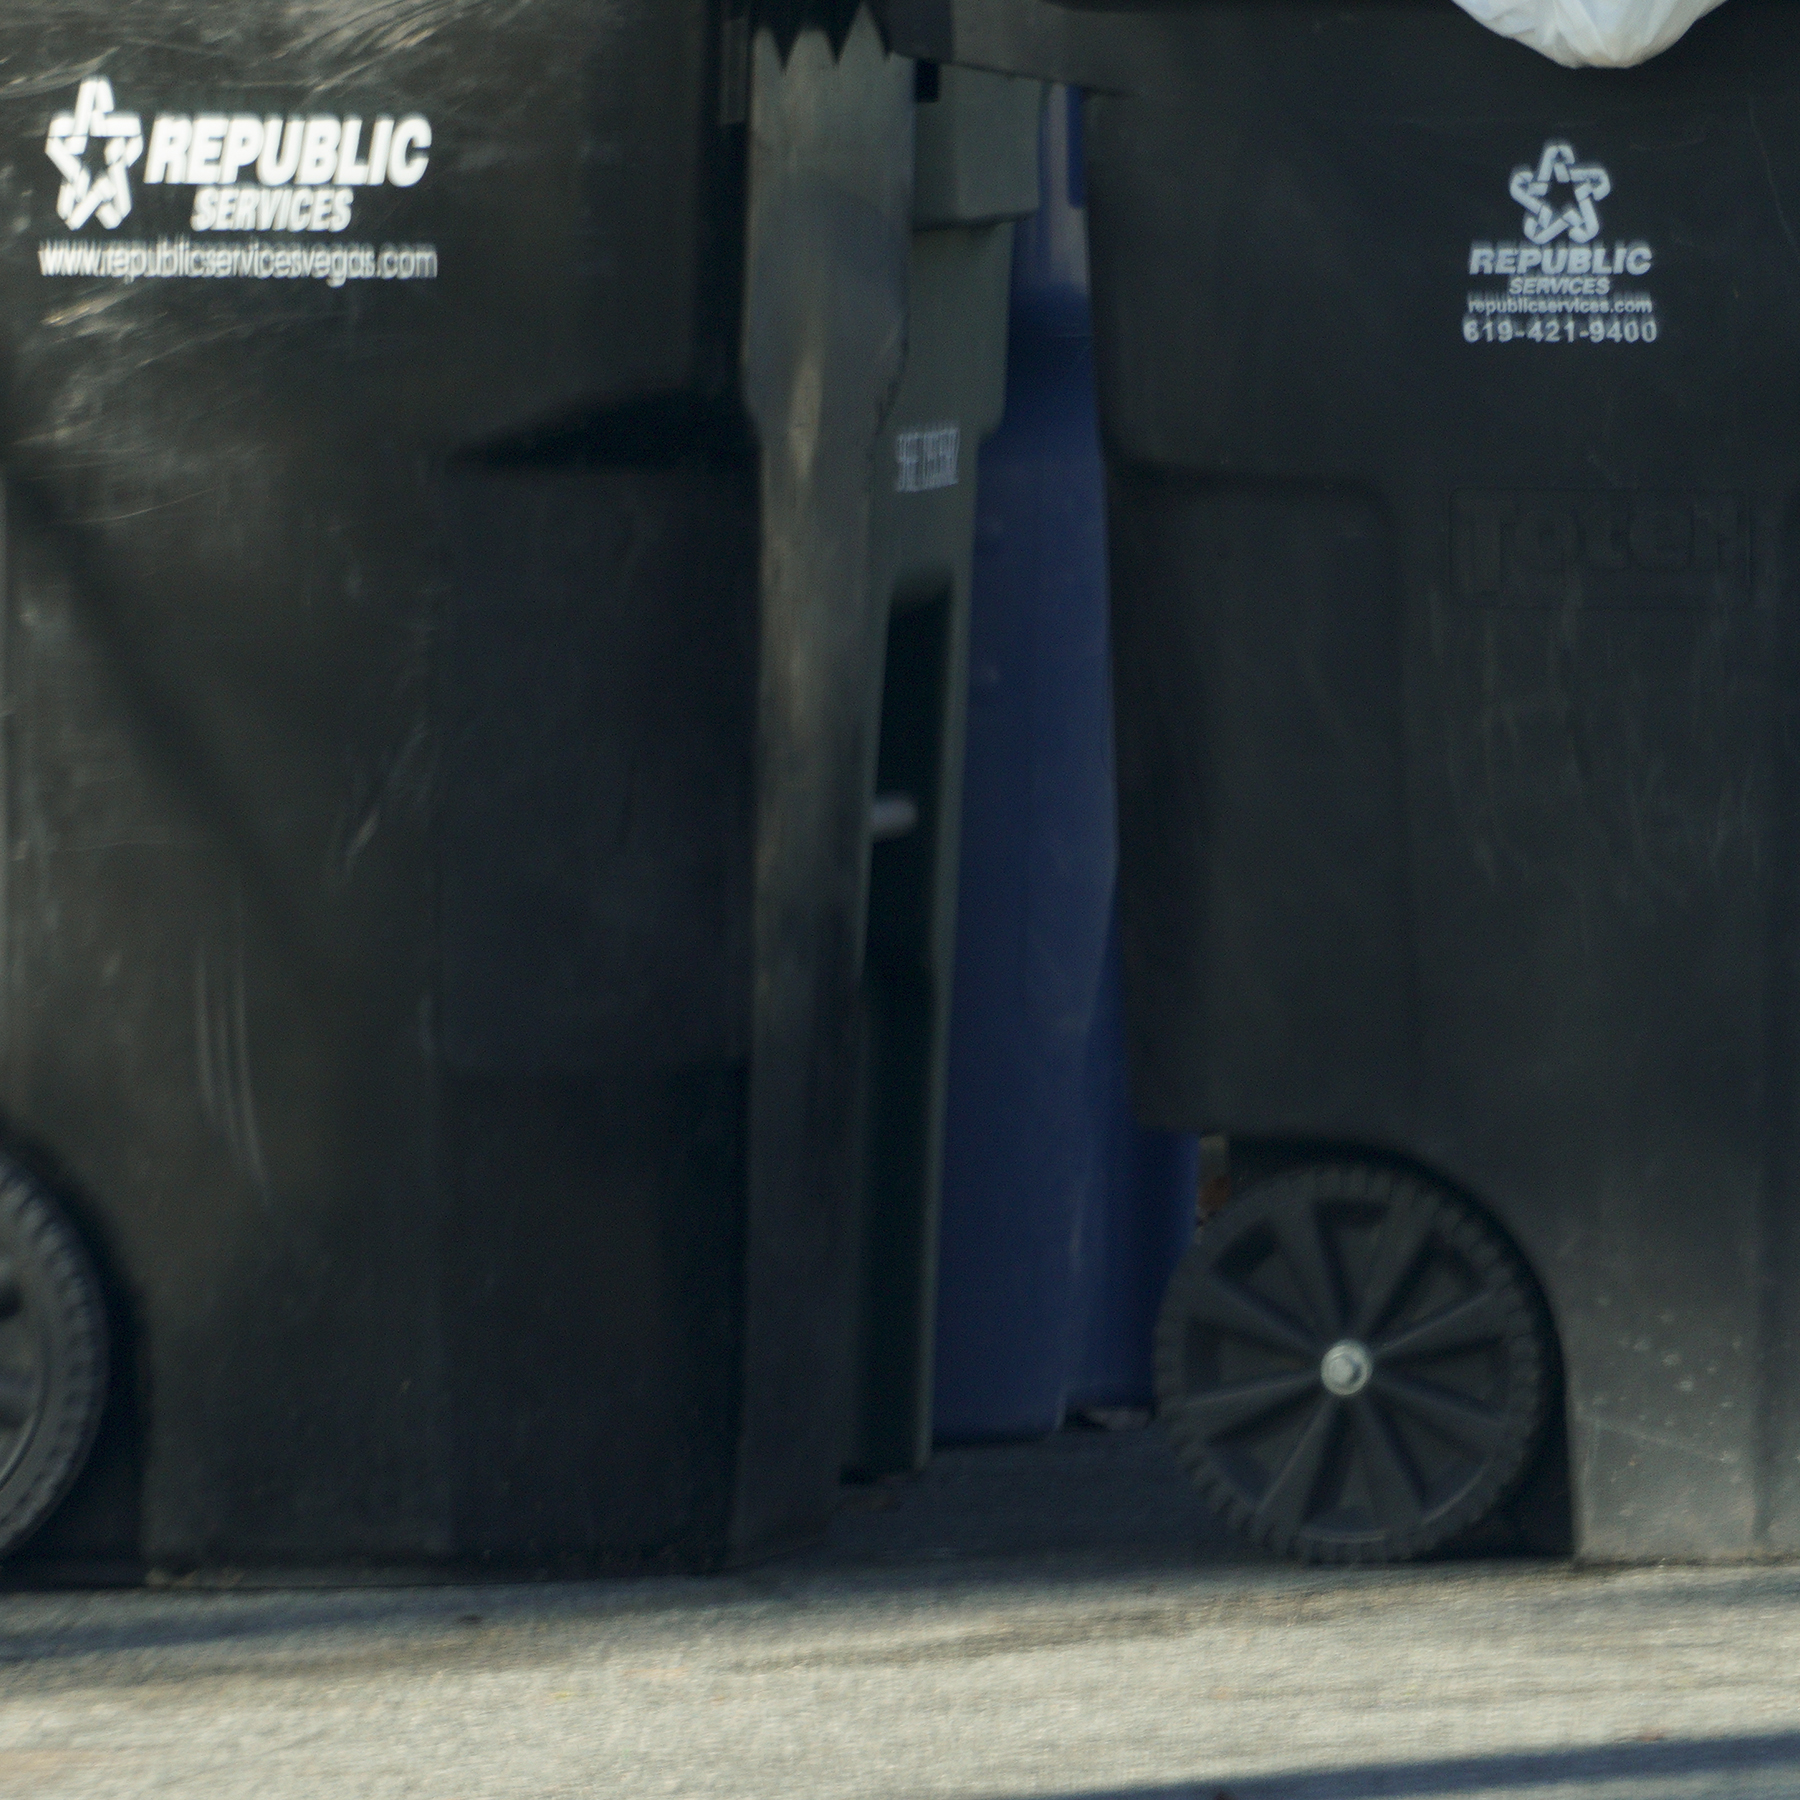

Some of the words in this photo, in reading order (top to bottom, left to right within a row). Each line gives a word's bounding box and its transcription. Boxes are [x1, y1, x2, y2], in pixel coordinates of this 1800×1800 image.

[143, 114, 433, 187] REPUBLIC
[189, 185, 355, 232] SERVICES
[38, 237, 438, 288] www.republicservicesvegas.com
[1468, 245, 1652, 275] REPUBLIC
[1508, 276, 1611, 295] SERVICES
[1467, 296, 1653, 315] republicservices.com
[1461, 317, 1658, 343] 619-421-9400
